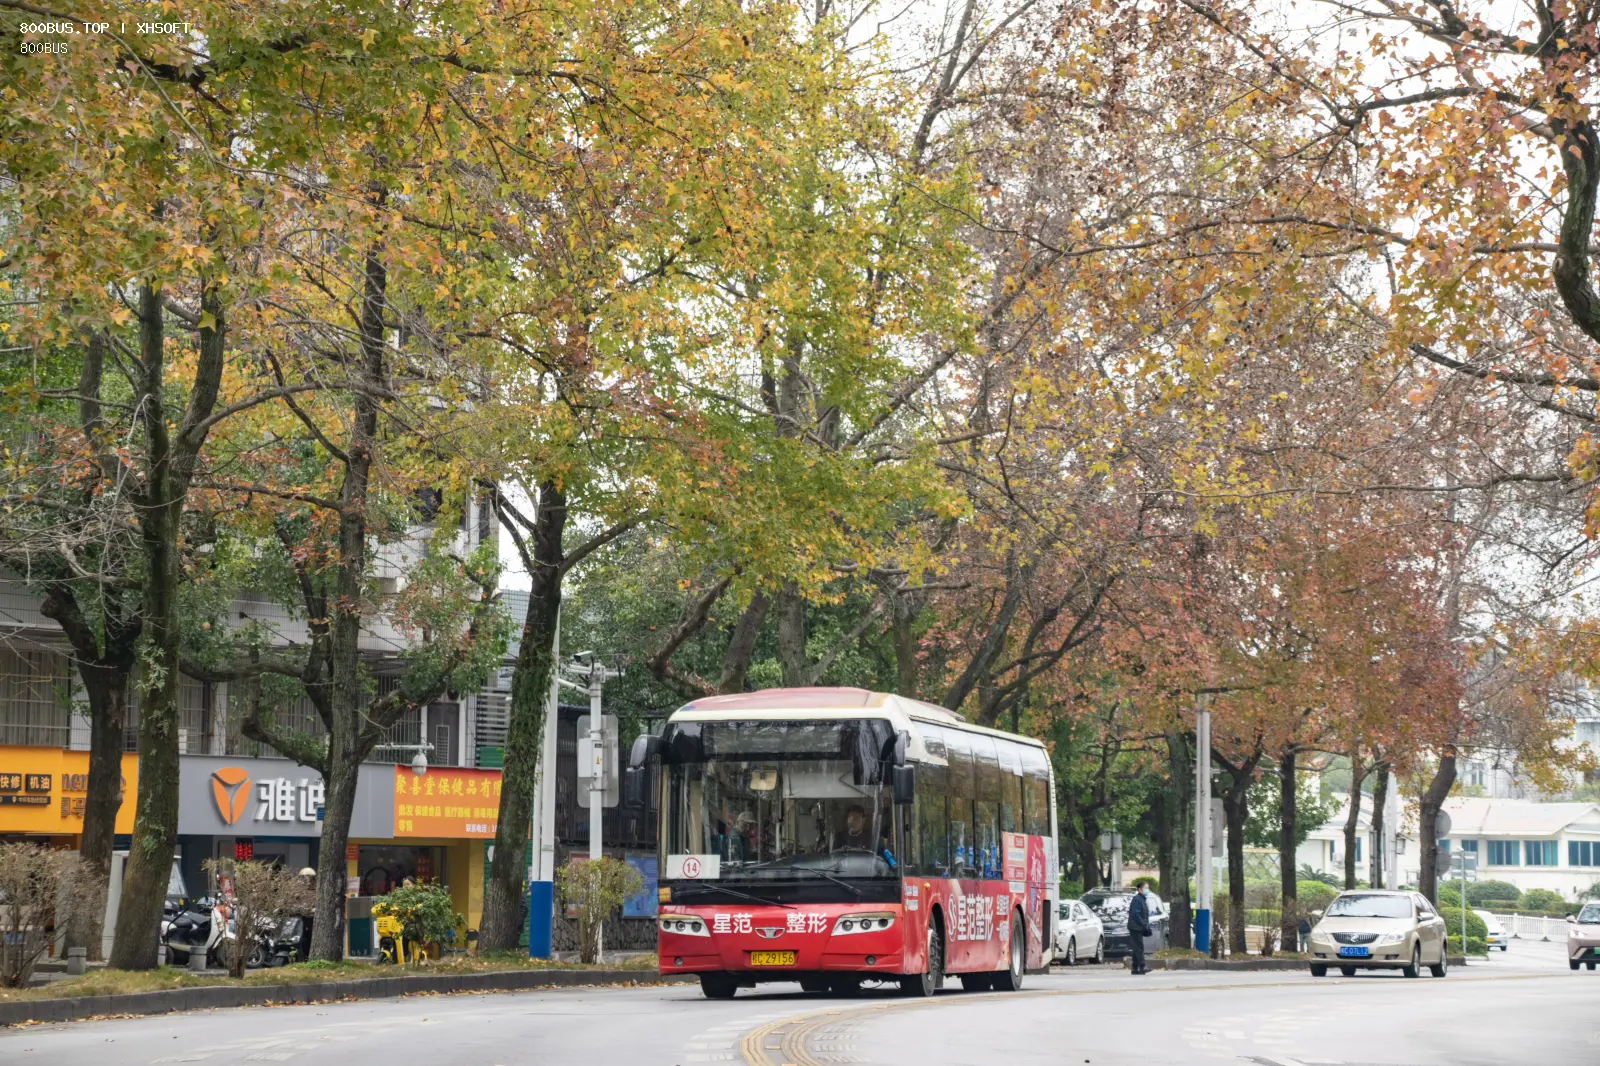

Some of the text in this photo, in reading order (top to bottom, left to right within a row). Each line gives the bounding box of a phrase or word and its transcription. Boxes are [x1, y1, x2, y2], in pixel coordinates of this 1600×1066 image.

[29, 776, 50, 789] 机油
[686, 861, 697, 874] 14
[712, 912, 828, 934] 星范 整形
[957, 894, 994, 941] 星范整形
